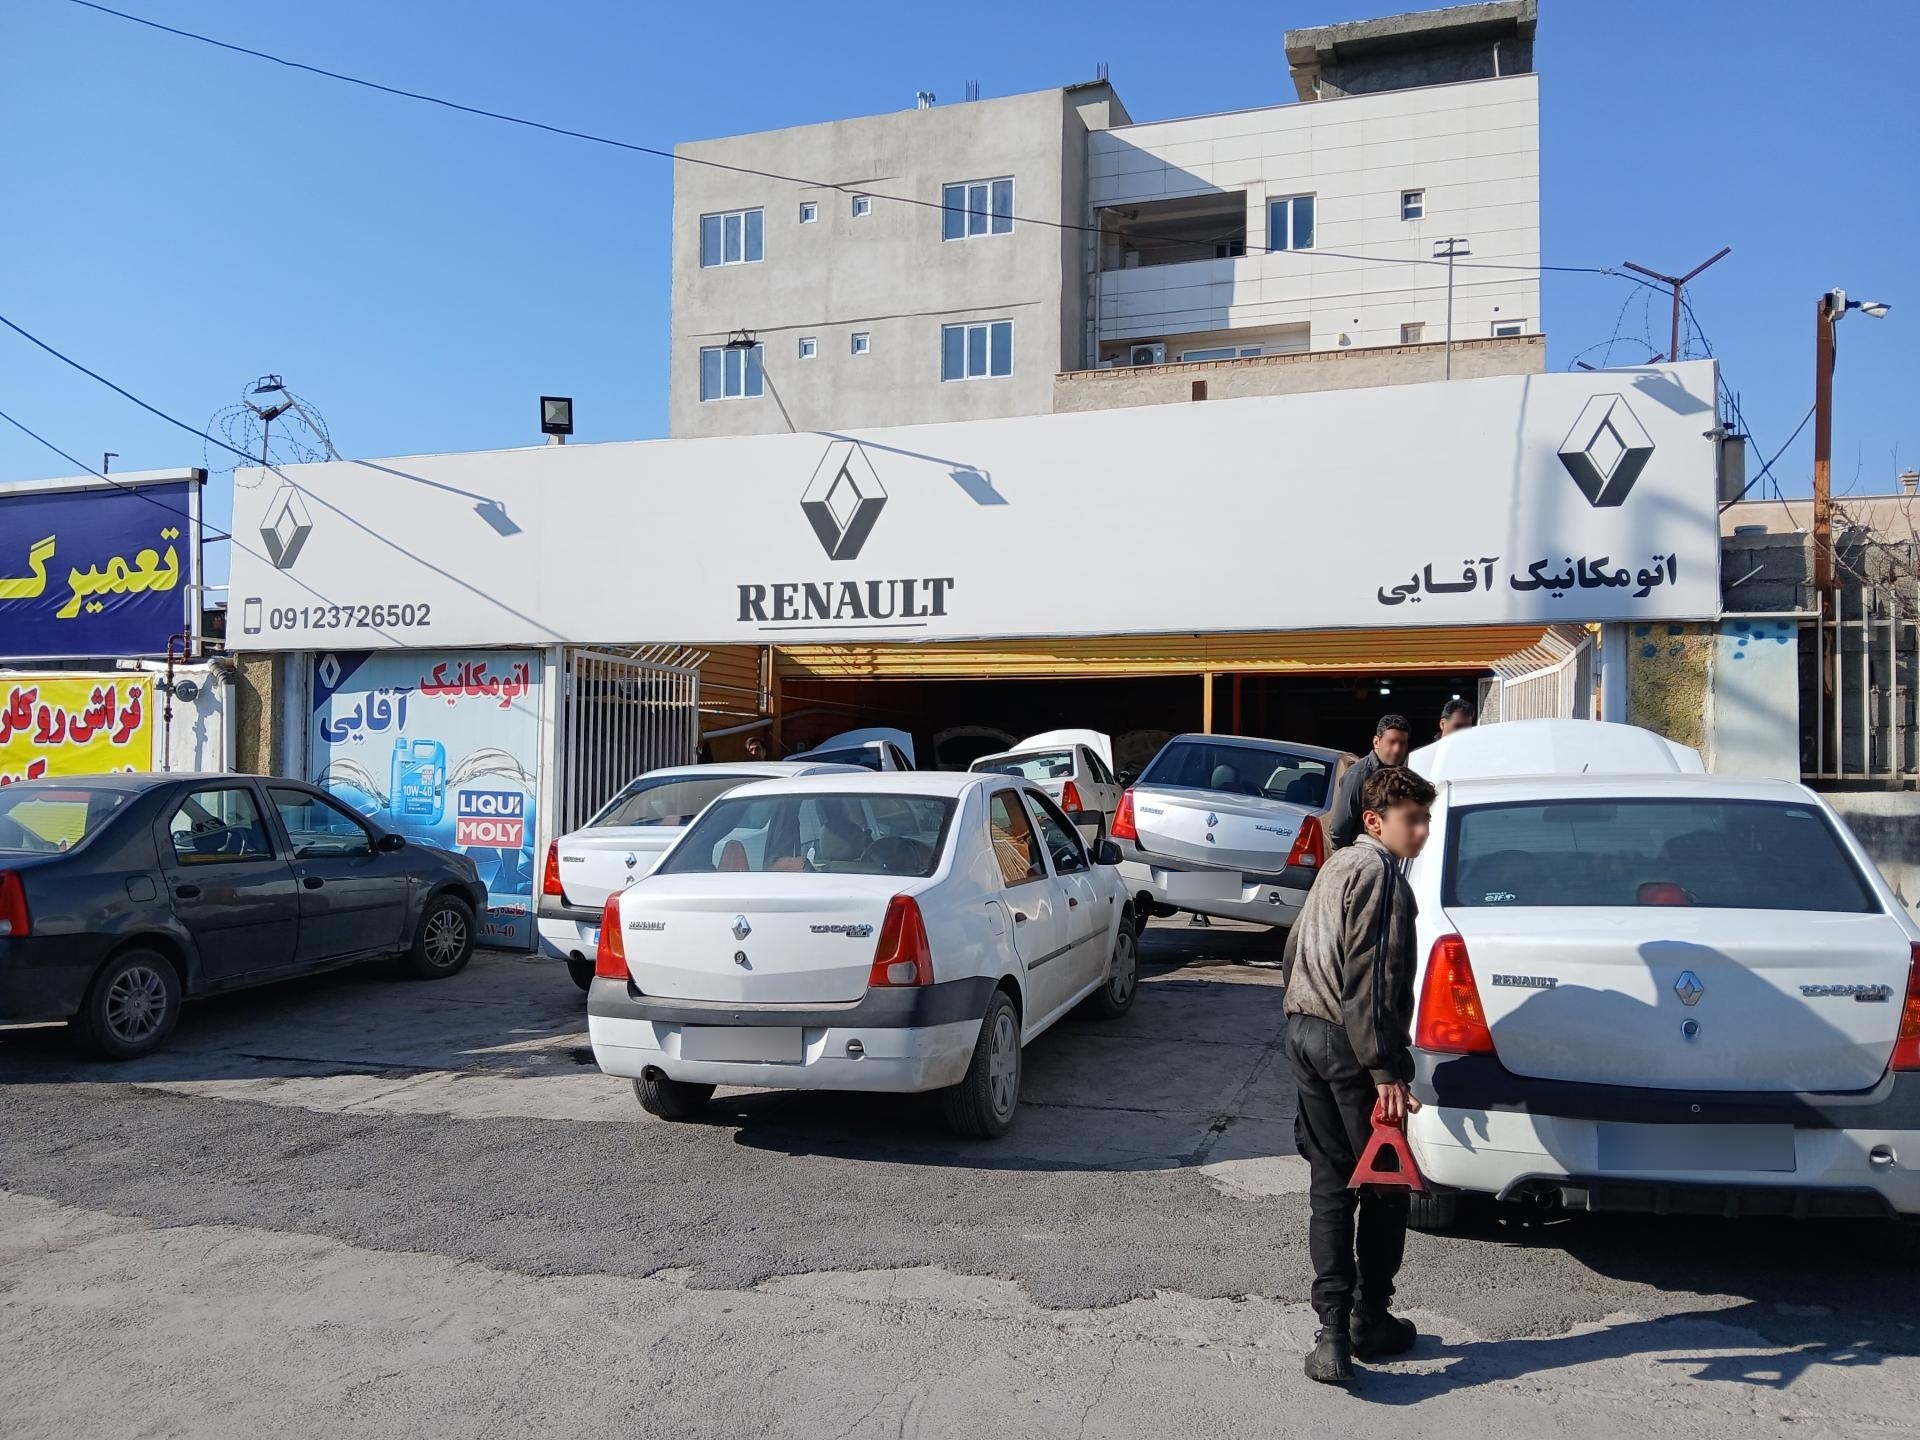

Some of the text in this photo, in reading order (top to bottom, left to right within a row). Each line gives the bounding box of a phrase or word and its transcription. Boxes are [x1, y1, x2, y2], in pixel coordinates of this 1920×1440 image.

[55, 526, 180, 619] تعمیر
[1377, 552, 1678, 606] اتومکانیک آقایی
[269, 603, 432, 631] 09123726502
[736, 577, 955, 622] RENAULT
[419, 660, 530, 709] اتومکانیک
[69, 685, 142, 744] تراش
[319, 686, 415, 743] آقایی
[402, 784, 433, 797] 10W-40
[459, 794, 521, 815] LIQUI
[457, 821, 522, 842] MOLY
[1491, 973, 1559, 990] RENAULT
